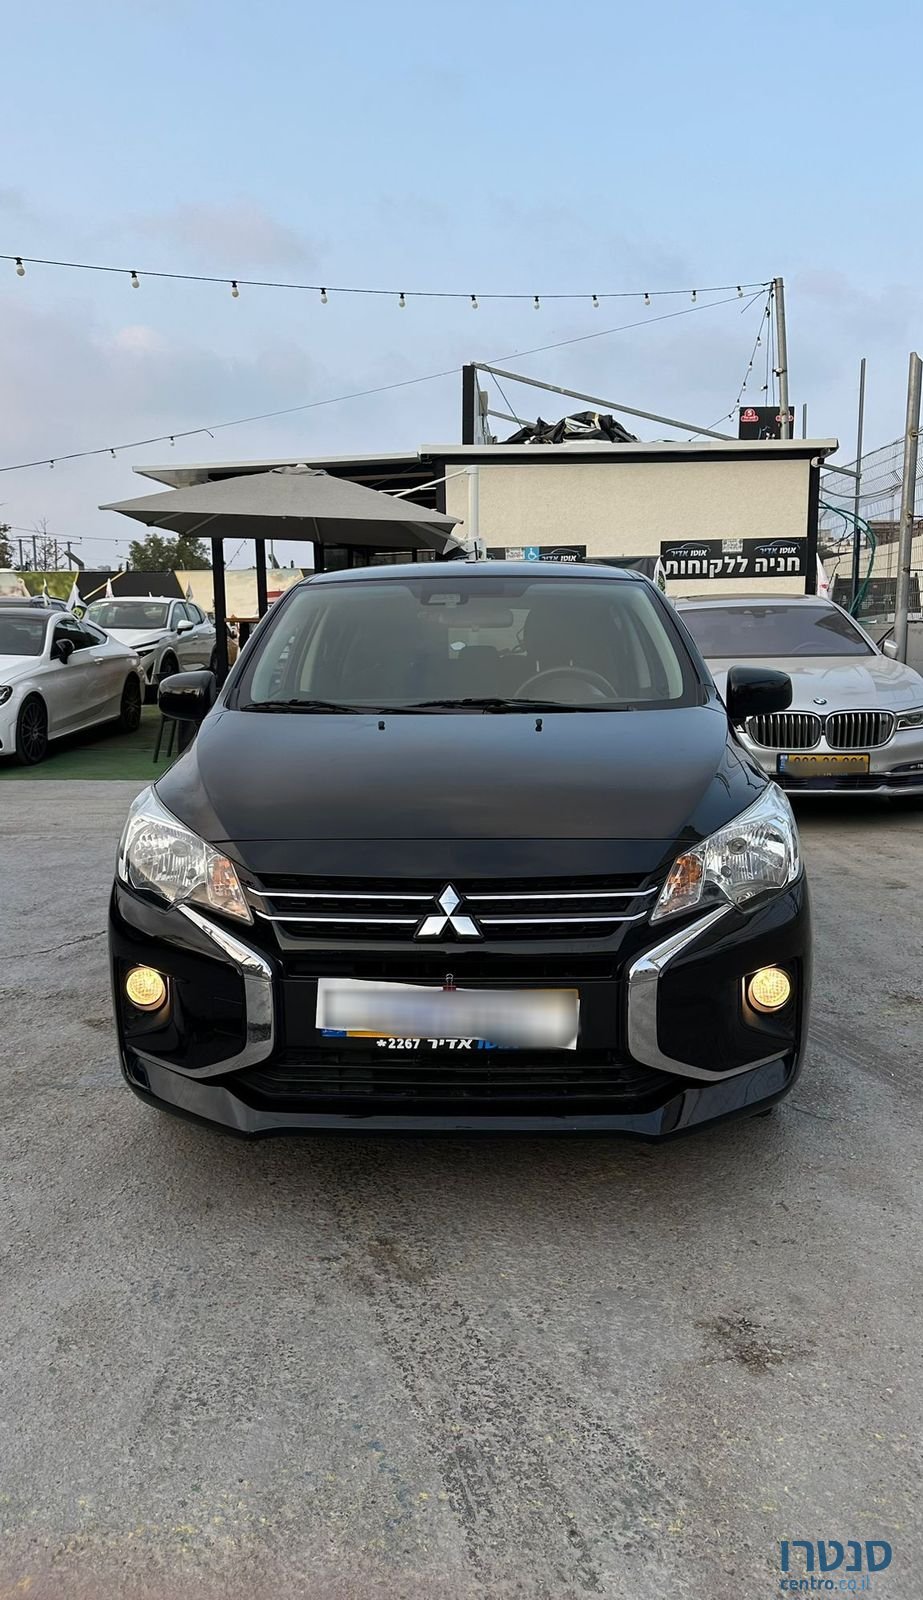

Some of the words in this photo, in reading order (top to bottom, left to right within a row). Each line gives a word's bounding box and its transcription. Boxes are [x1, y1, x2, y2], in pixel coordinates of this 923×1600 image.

[665, 555, 749, 578] ללקוחות
[755, 557, 800, 572] חניה
[427, 1039, 472, 1049] אדיר
